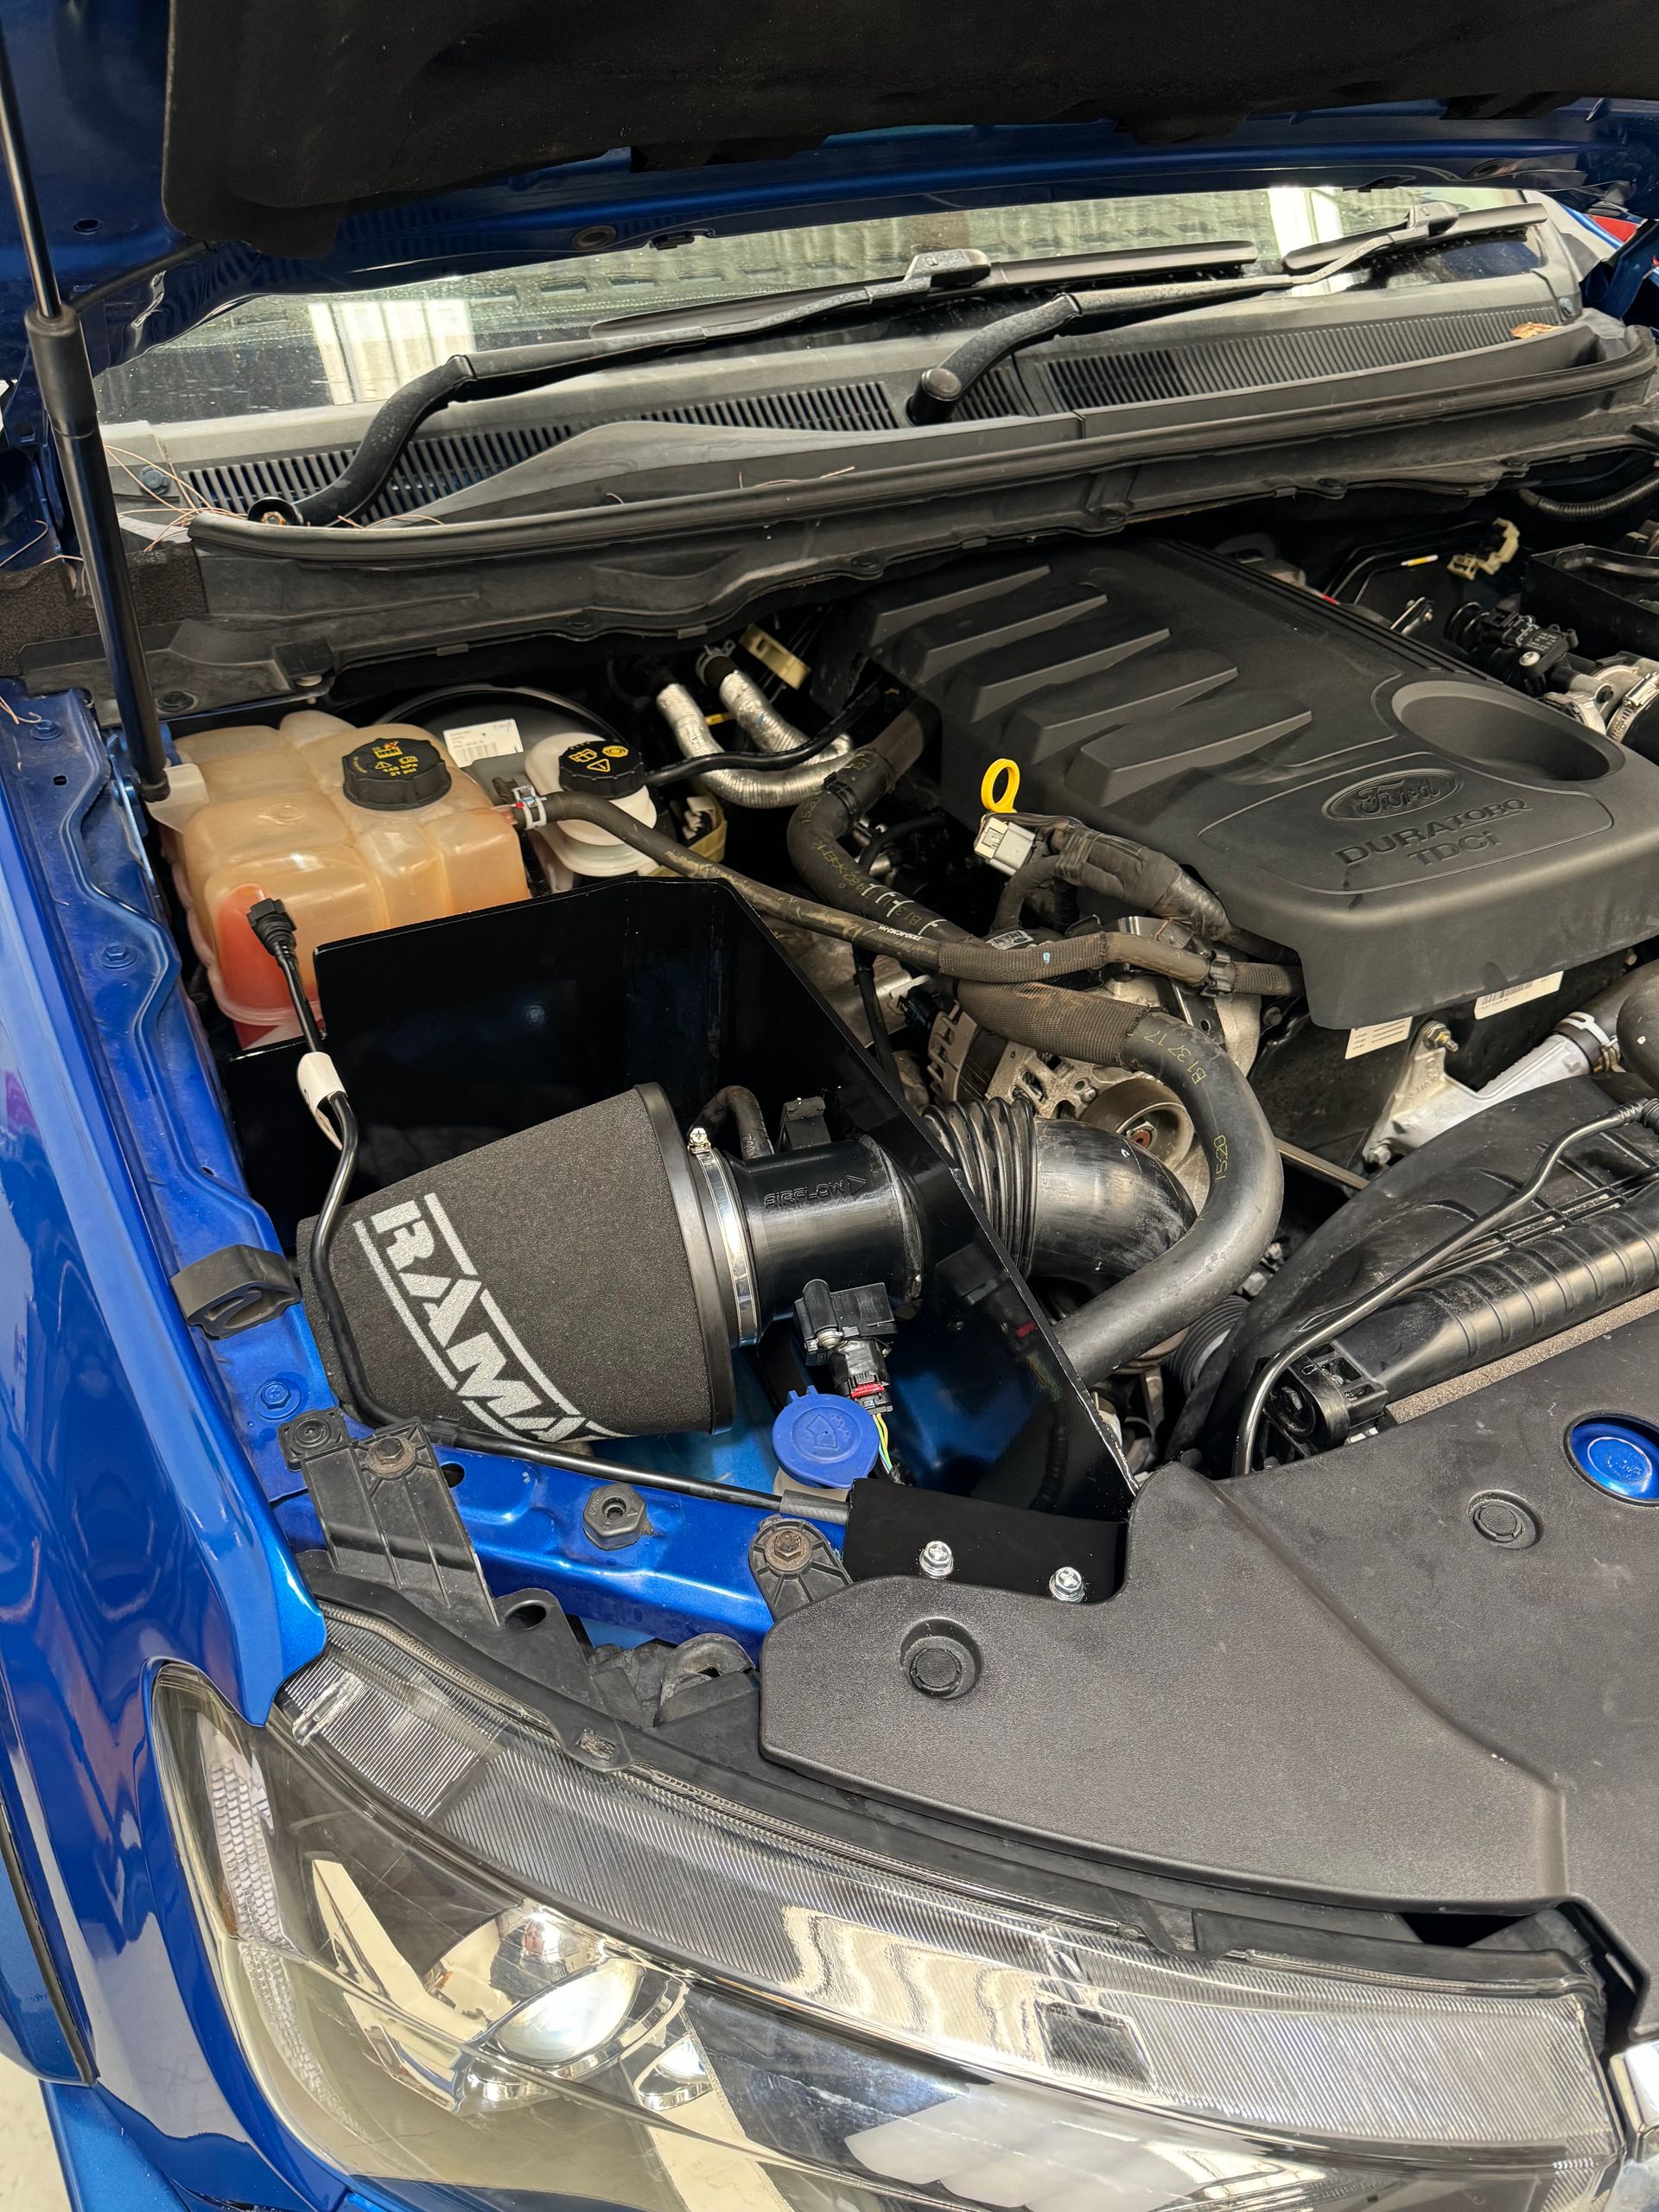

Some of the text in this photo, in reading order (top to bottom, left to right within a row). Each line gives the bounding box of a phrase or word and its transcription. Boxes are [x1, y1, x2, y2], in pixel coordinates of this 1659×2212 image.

[1355, 778, 1440, 815] Ford
[1335, 798, 1532, 865] DURATORQ
[1407, 830, 1501, 866] TDCi
[1213, 1135, 1229, 1183] 1520
[764, 1179, 844, 1210] AIRFLOW
